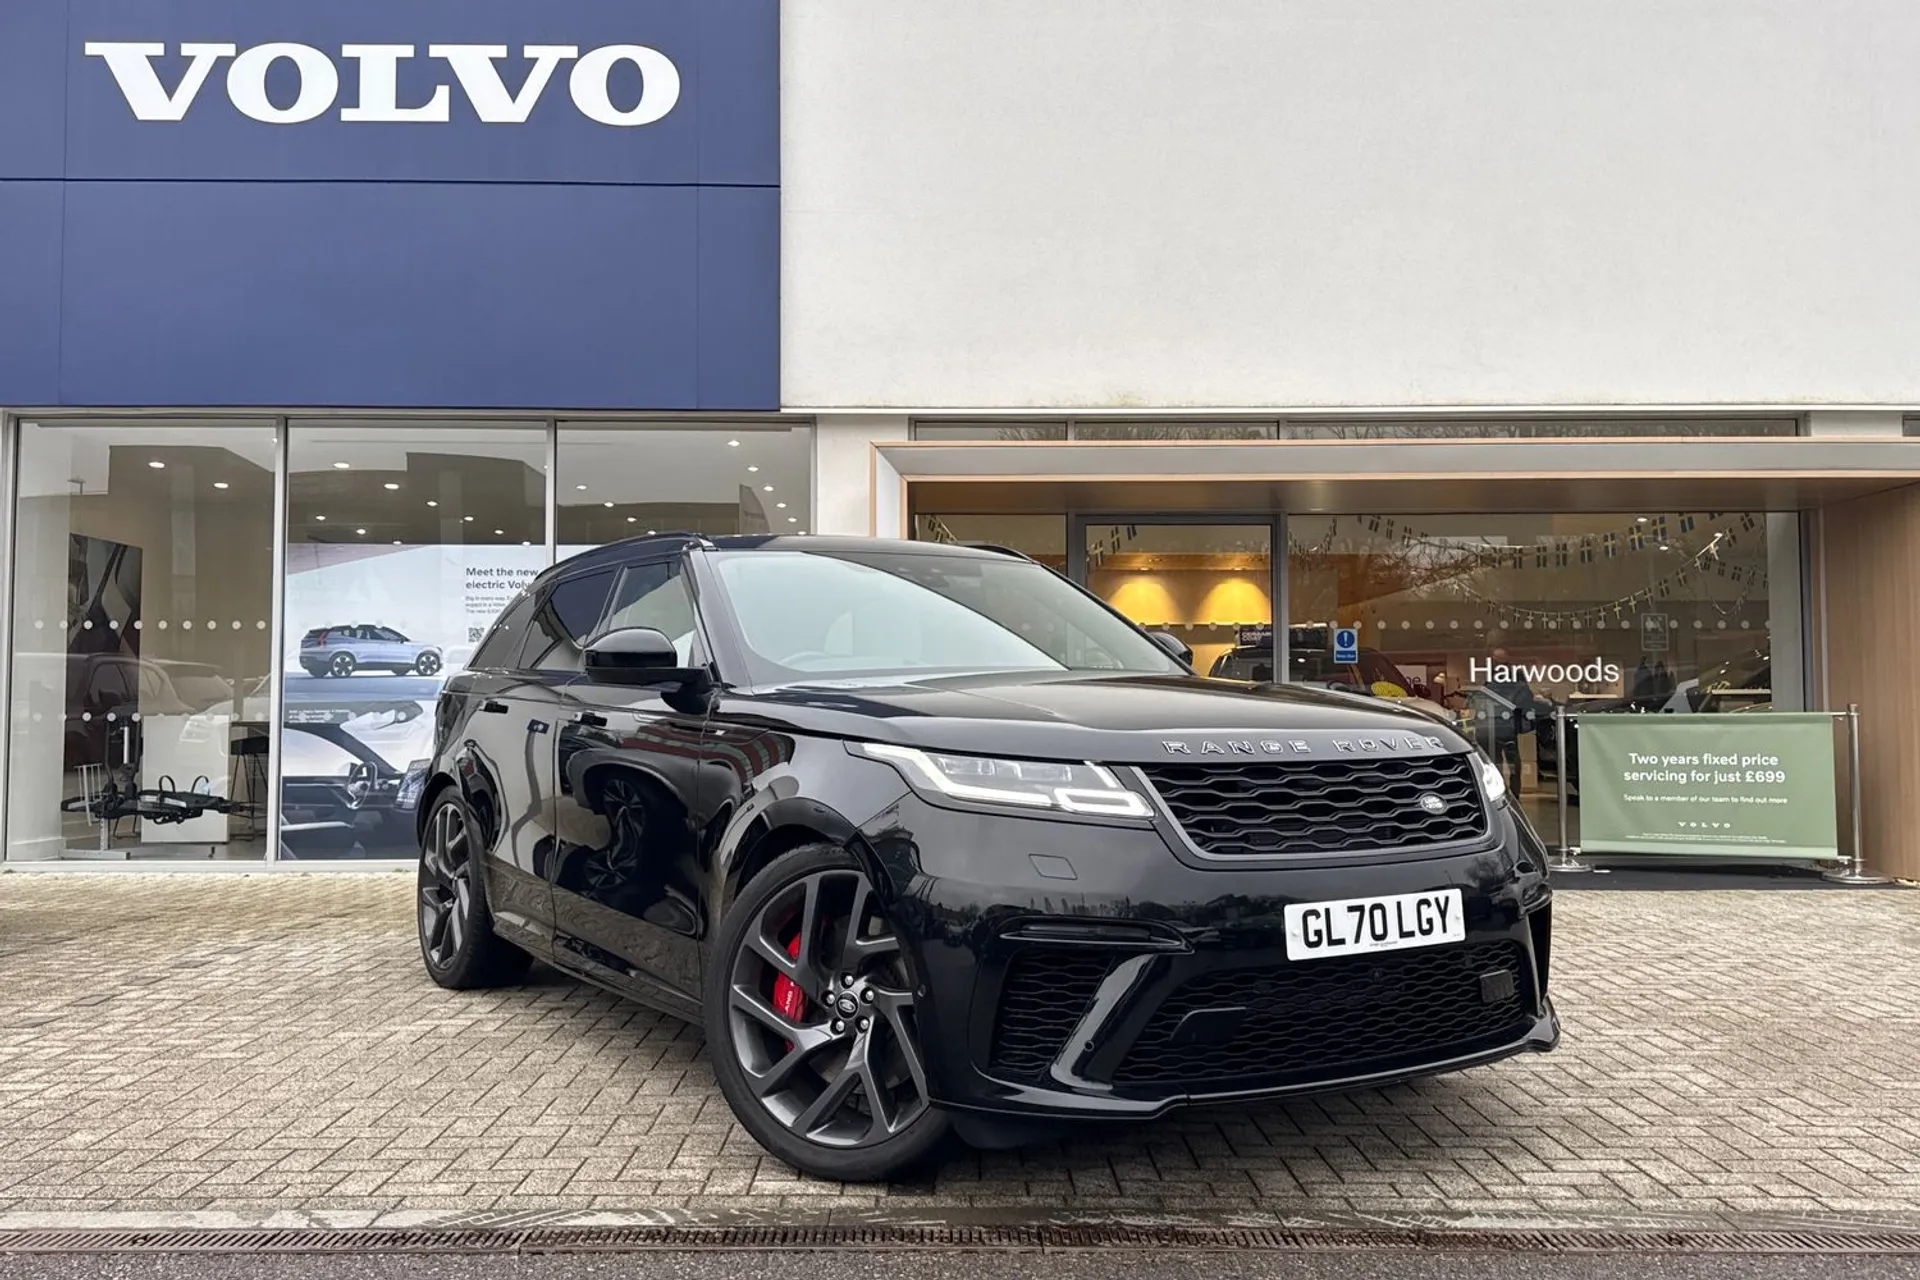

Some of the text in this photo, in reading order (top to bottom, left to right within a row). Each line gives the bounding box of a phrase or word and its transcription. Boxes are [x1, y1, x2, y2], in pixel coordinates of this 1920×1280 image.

[85, 41, 681, 127] VOLVO
[466, 567, 538, 577] Meet the new
[465, 580, 505, 589] electric
[1469, 656, 1620, 683] Harwoods
[1162, 735, 1445, 755] RANGE ROVER
[1628, 752, 1779, 768] Two years fixed price
[1623, 769, 1786, 785] servicing for just £699
[1623, 794, 1645, 802] Speak
[1660, 794, 1689, 802] member
[1302, 896, 1450, 949] GL70 LGY
